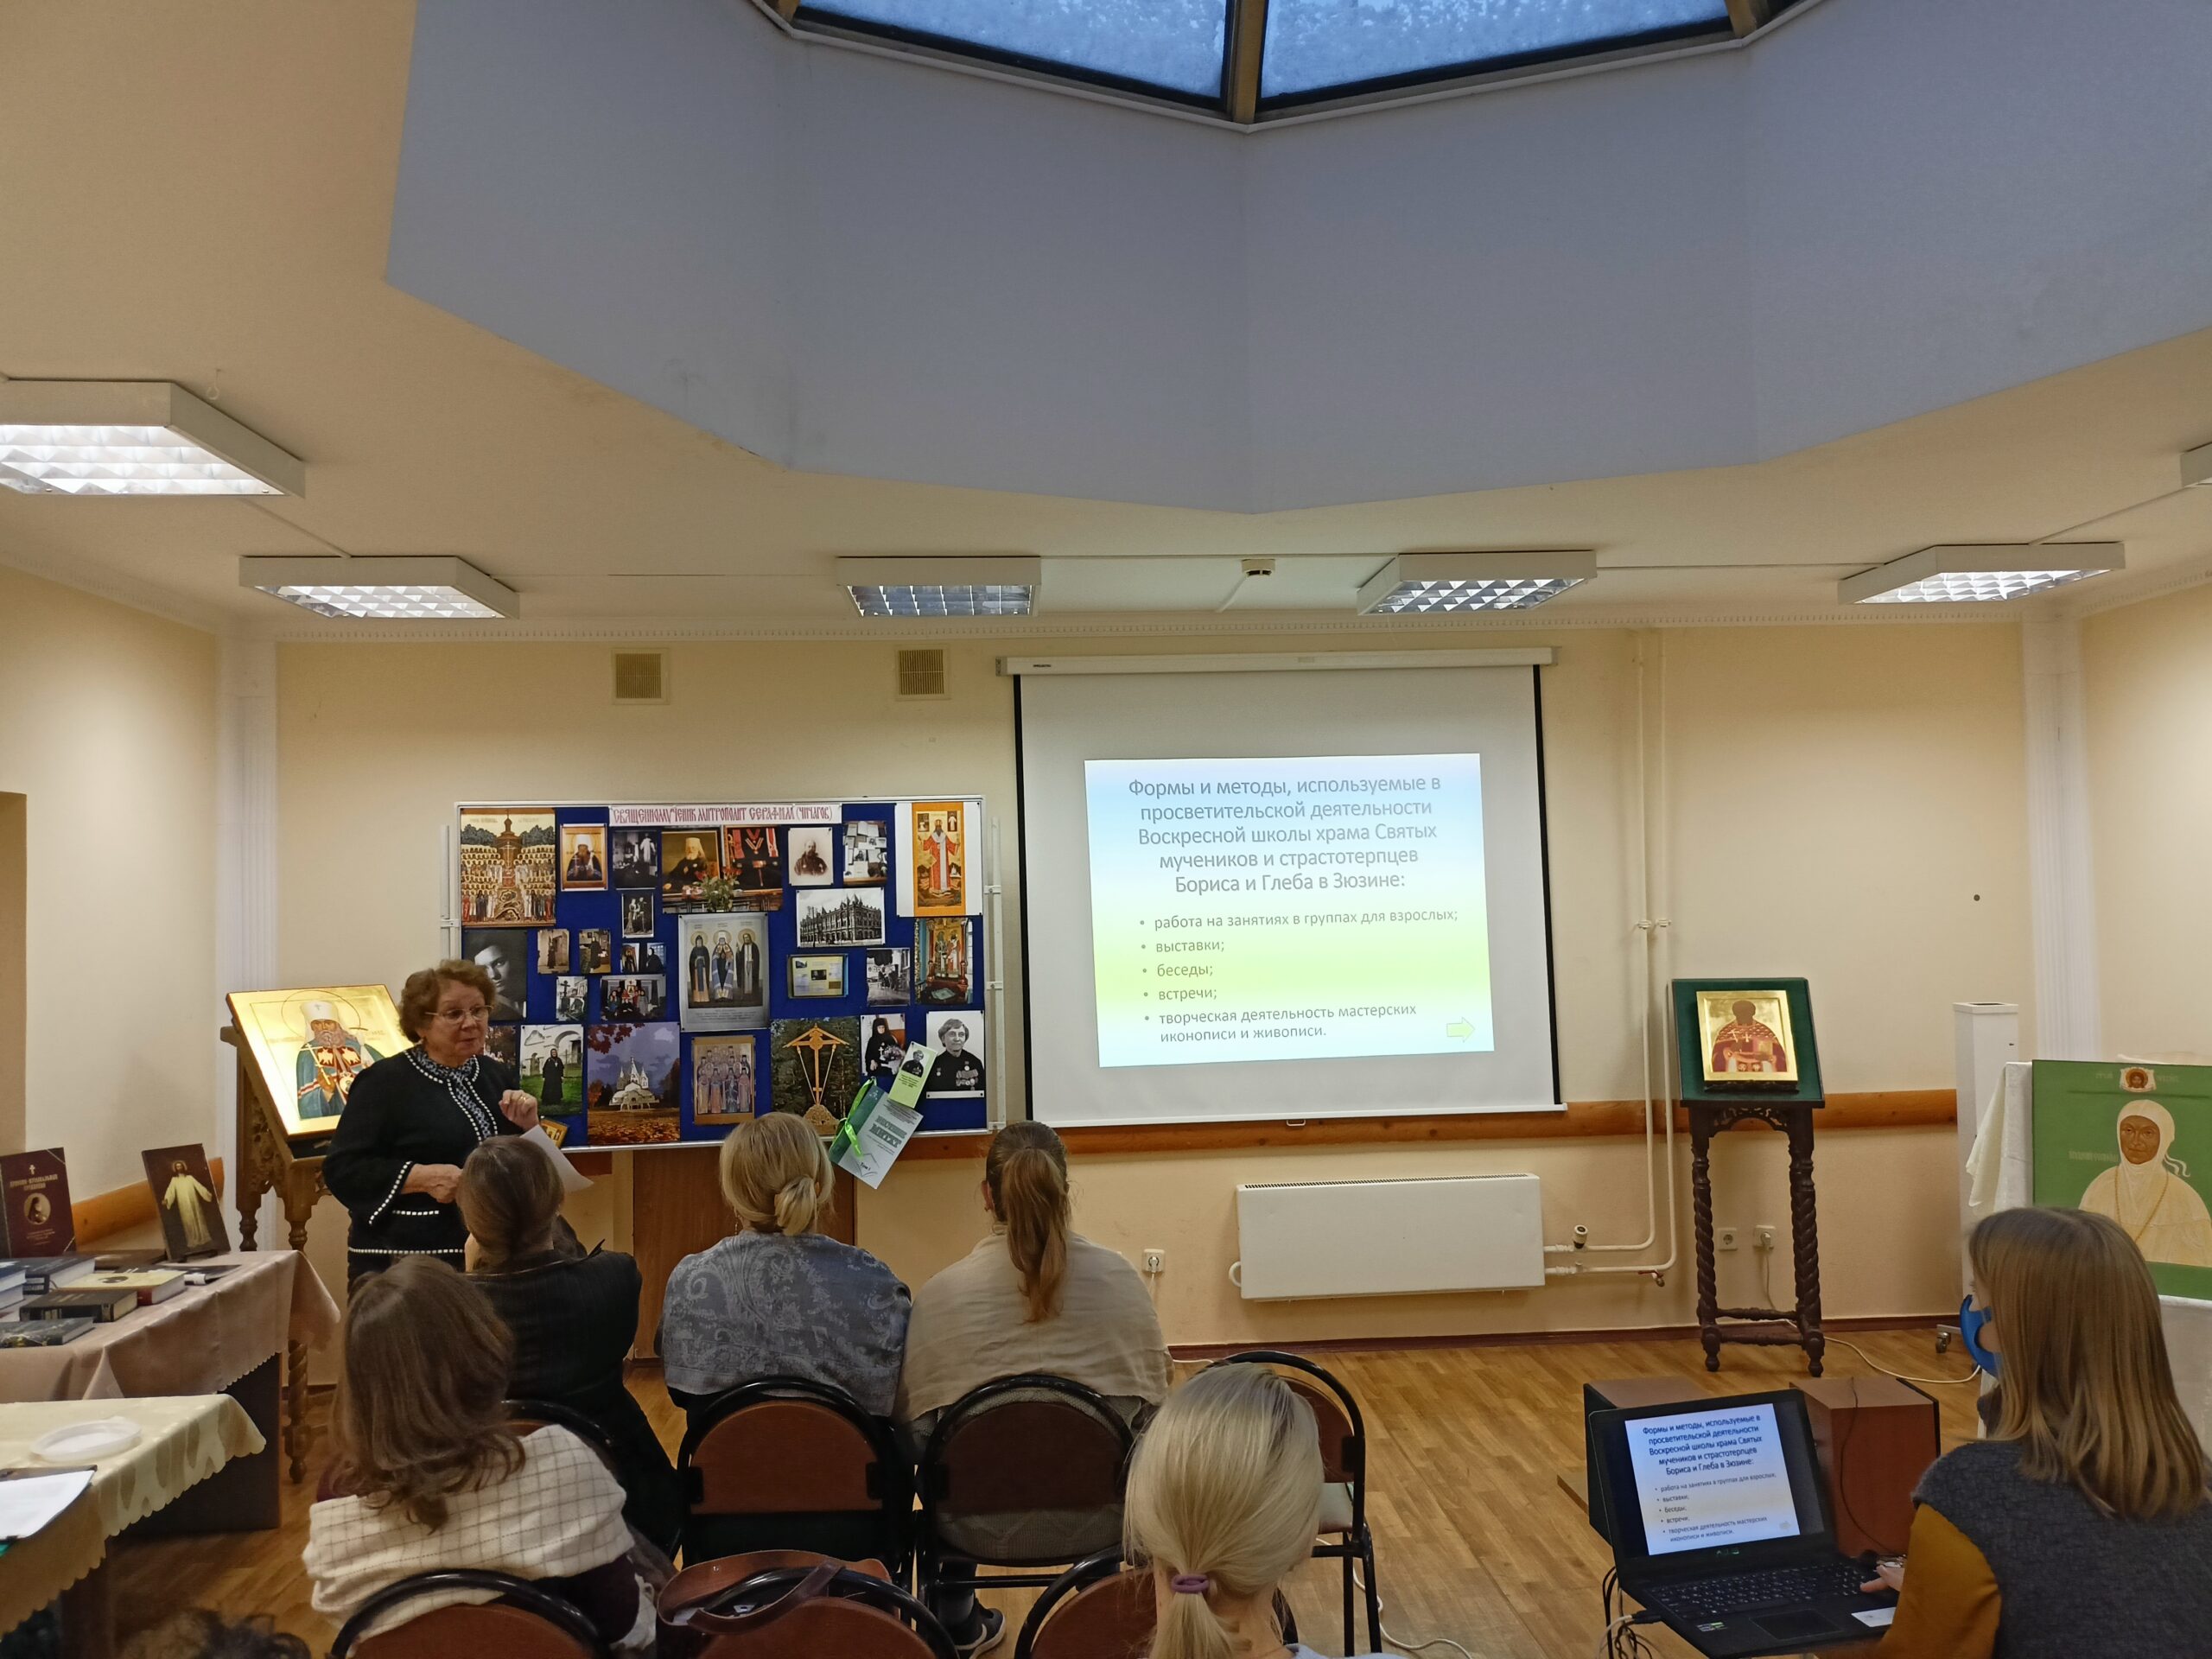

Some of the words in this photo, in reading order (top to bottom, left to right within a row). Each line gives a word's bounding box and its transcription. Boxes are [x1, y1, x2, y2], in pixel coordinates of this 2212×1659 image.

[1128, 779, 1194, 800] Формы
[1201, 781, 1211, 794] и
[1217, 779, 1292, 797] методы,
[1297, 776, 1426, 794] используемые
[1431, 776, 1440, 790] в
[1141, 801, 1305, 824] просветительской
[1311, 801, 1432, 819] деятельности
[1139, 826, 1245, 848] Воскресной
[1251, 826, 1311, 842] школы
[1316, 828, 1370, 843] храма
[1376, 823, 1437, 840] Святых
[1160, 853, 1258, 873] мучеников
[1264, 853, 1274, 866] и
[1280, 849, 1419, 868] страстотерпцев
[1175, 876, 1240, 896] Бориса
[1246, 879, 1255, 891] и
[1262, 874, 1313, 890] Глеба
[1319, 876, 1328, 888] в
[1333, 873, 1406, 888] Зюзине:
[1154, 914, 1202, 931] работа
[1206, 917, 1223, 927] на
[1227, 914, 1288, 926] занятиях
[1294, 914, 1300, 925] в
[1305, 912, 1357, 927] группах
[1361, 911, 1385, 924] для
[1390, 908, 1459, 925] взрослых;
[1156, 940, 1224, 953] выставки;
[1156, 963, 1213, 978] беседы;
[1159, 988, 1217, 1002] встречи;
[1160, 1012, 1236, 1026] творческая
[1241, 1007, 1334, 1024] деятельность
[1338, 1003, 1416, 1018] мастерских
[1160, 1028, 1236, 1044] иконописи
[1240, 1028, 1249, 1039] и
[1254, 1026, 1326, 1040] живописи.
[1706, 1416, 1754, 1427] используемые
[1649, 1431, 1711, 1445] просветительской
[1713, 1427, 1758, 1438] деятельности
[1649, 1444, 1690, 1455] Воскресной
[1717, 1439, 1737, 1447] храма
[1659, 1456, 1696, 1465] мучеников
[1704, 1447, 1757, 1459] страстотерпцев
[1666, 1465, 1691, 1475] Бориса
[1699, 1461, 1719, 1470] Глеба
